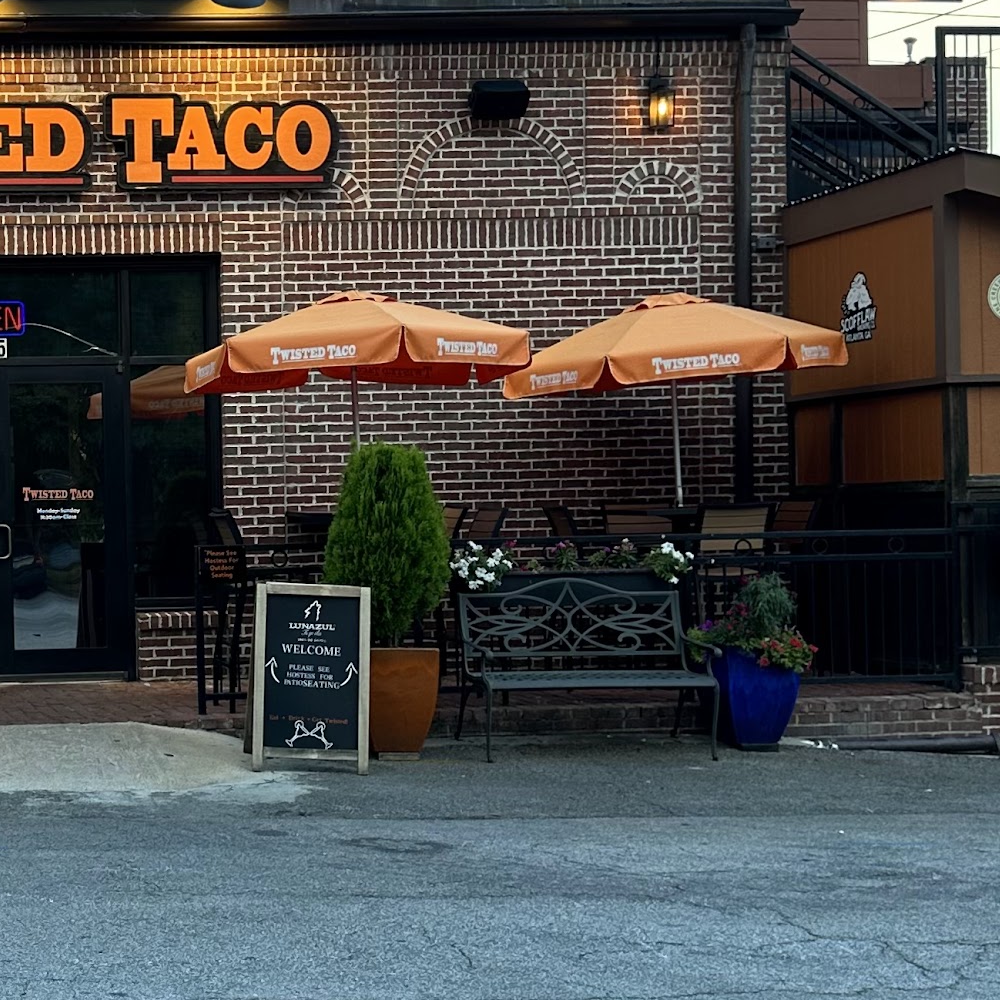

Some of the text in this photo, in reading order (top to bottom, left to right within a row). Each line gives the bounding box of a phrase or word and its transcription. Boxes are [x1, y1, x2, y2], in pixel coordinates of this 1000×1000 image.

[112, 98, 332, 184] TACO
[270, 344, 357, 365] TWISTED TACO
[437, 337, 498, 357] TWISTED TACO
[652, 353, 740, 375] TWISTED TACO
[22, 487, 94, 501] TWISTED TACO
[288, 622, 336, 631] LUNAZUL
[282, 643, 341, 657] WELCOME
[286, 671, 315, 679] HOSTESS
